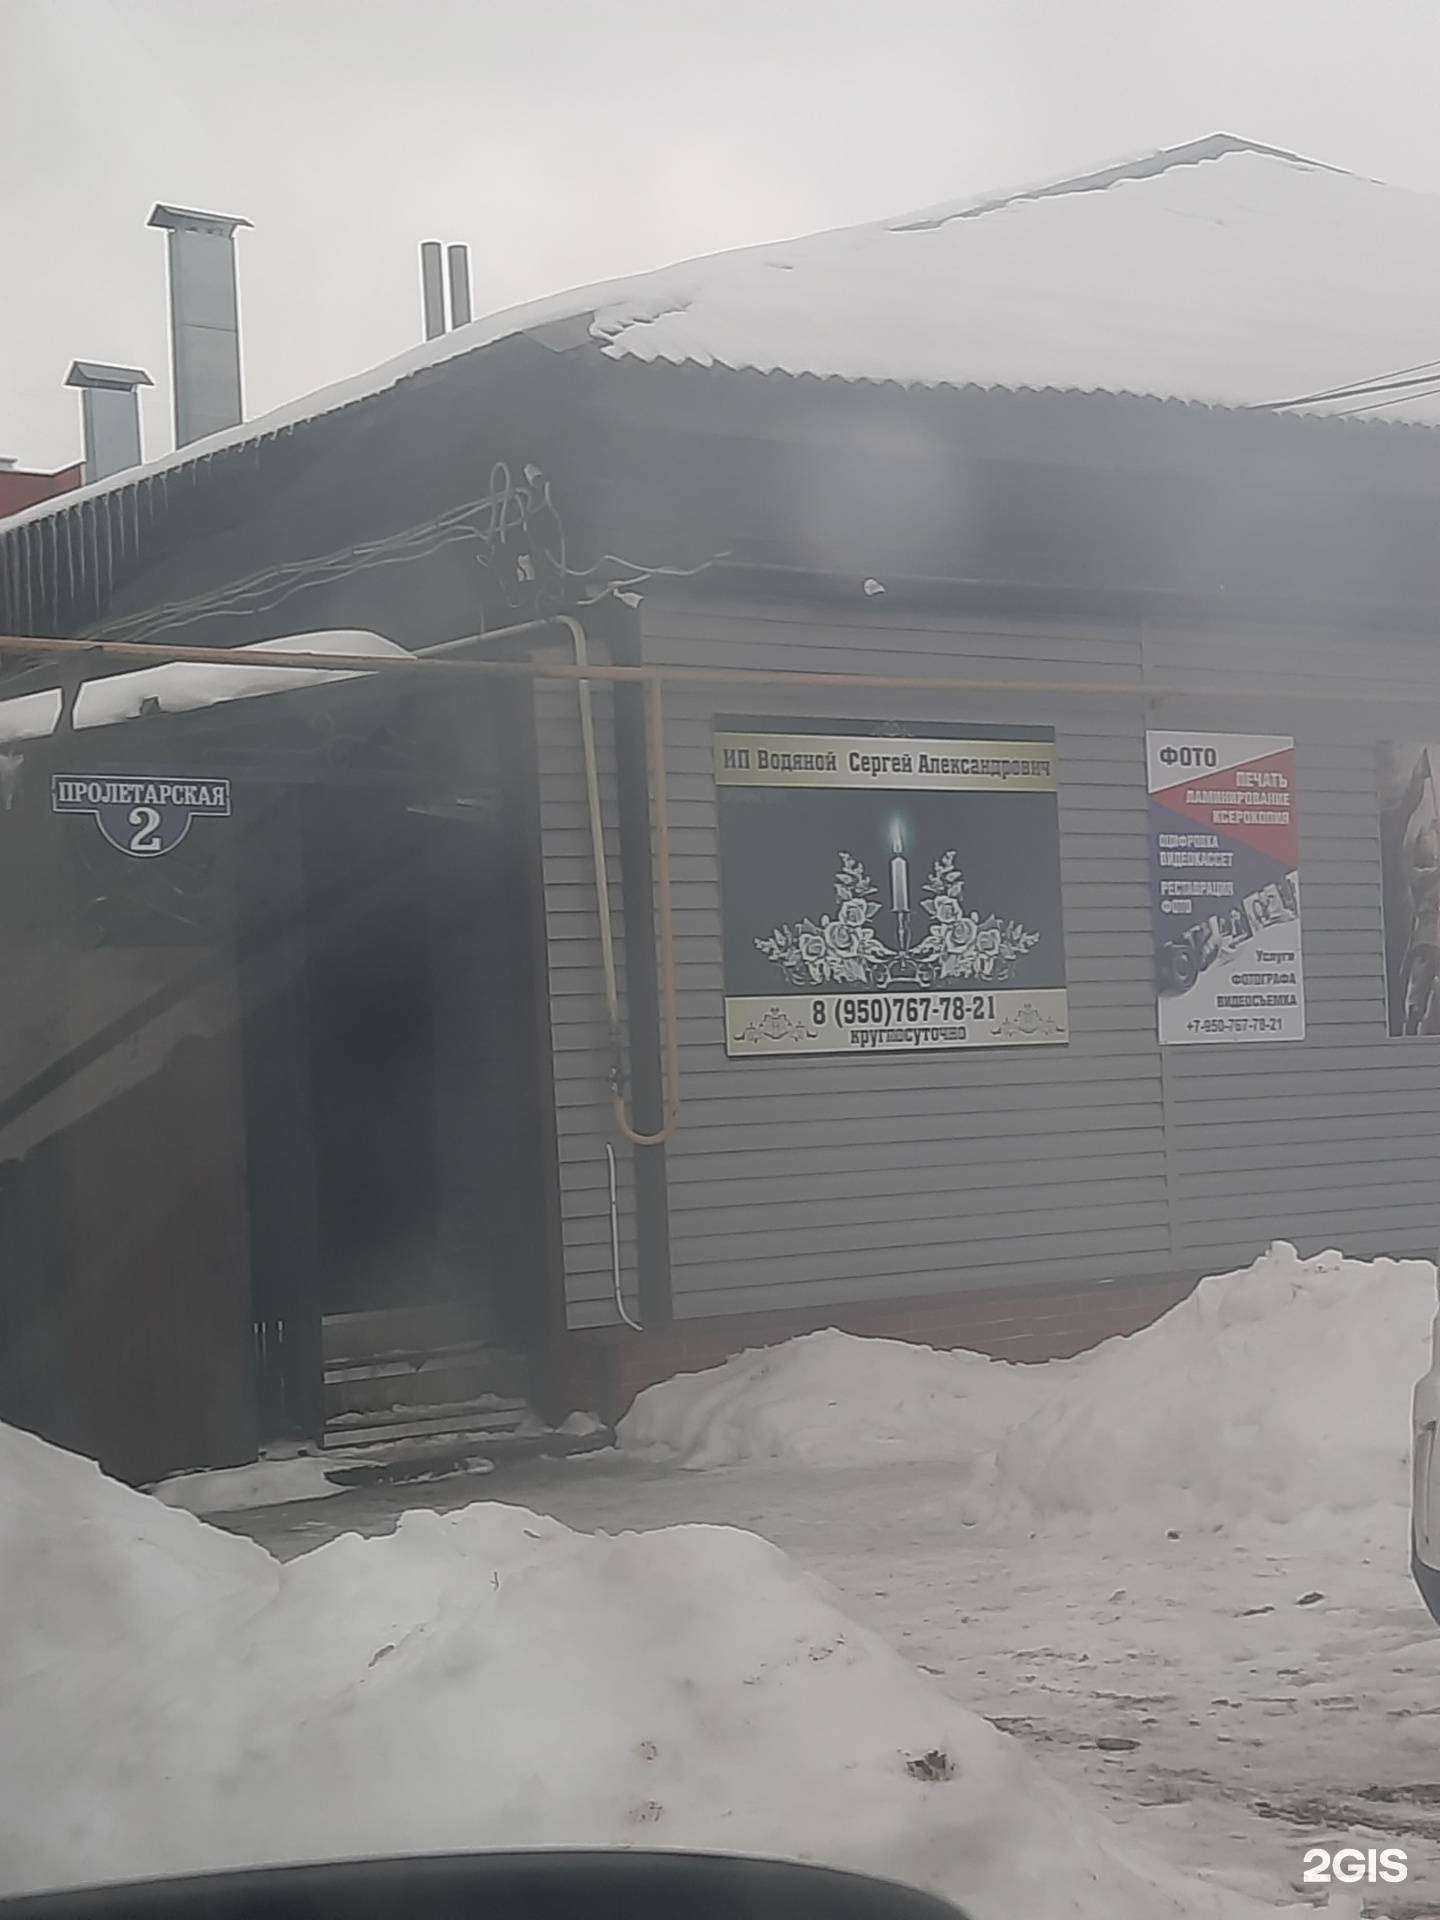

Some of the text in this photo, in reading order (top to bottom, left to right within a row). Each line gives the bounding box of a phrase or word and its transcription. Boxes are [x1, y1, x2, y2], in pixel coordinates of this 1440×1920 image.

[723, 749, 1051, 780] ИП Водяной Сергей Александрович
[1160, 746, 1217, 767] ФОТО
[1236, 771, 1288, 788] ПЕЧАТЬ
[58, 781, 225, 806] ПРОЛЕТАРСКАЯ
[128, 806, 162, 851] 2
[812, 1000, 826, 1025] 8
[850, 1025, 967, 1047] круглосуточно
